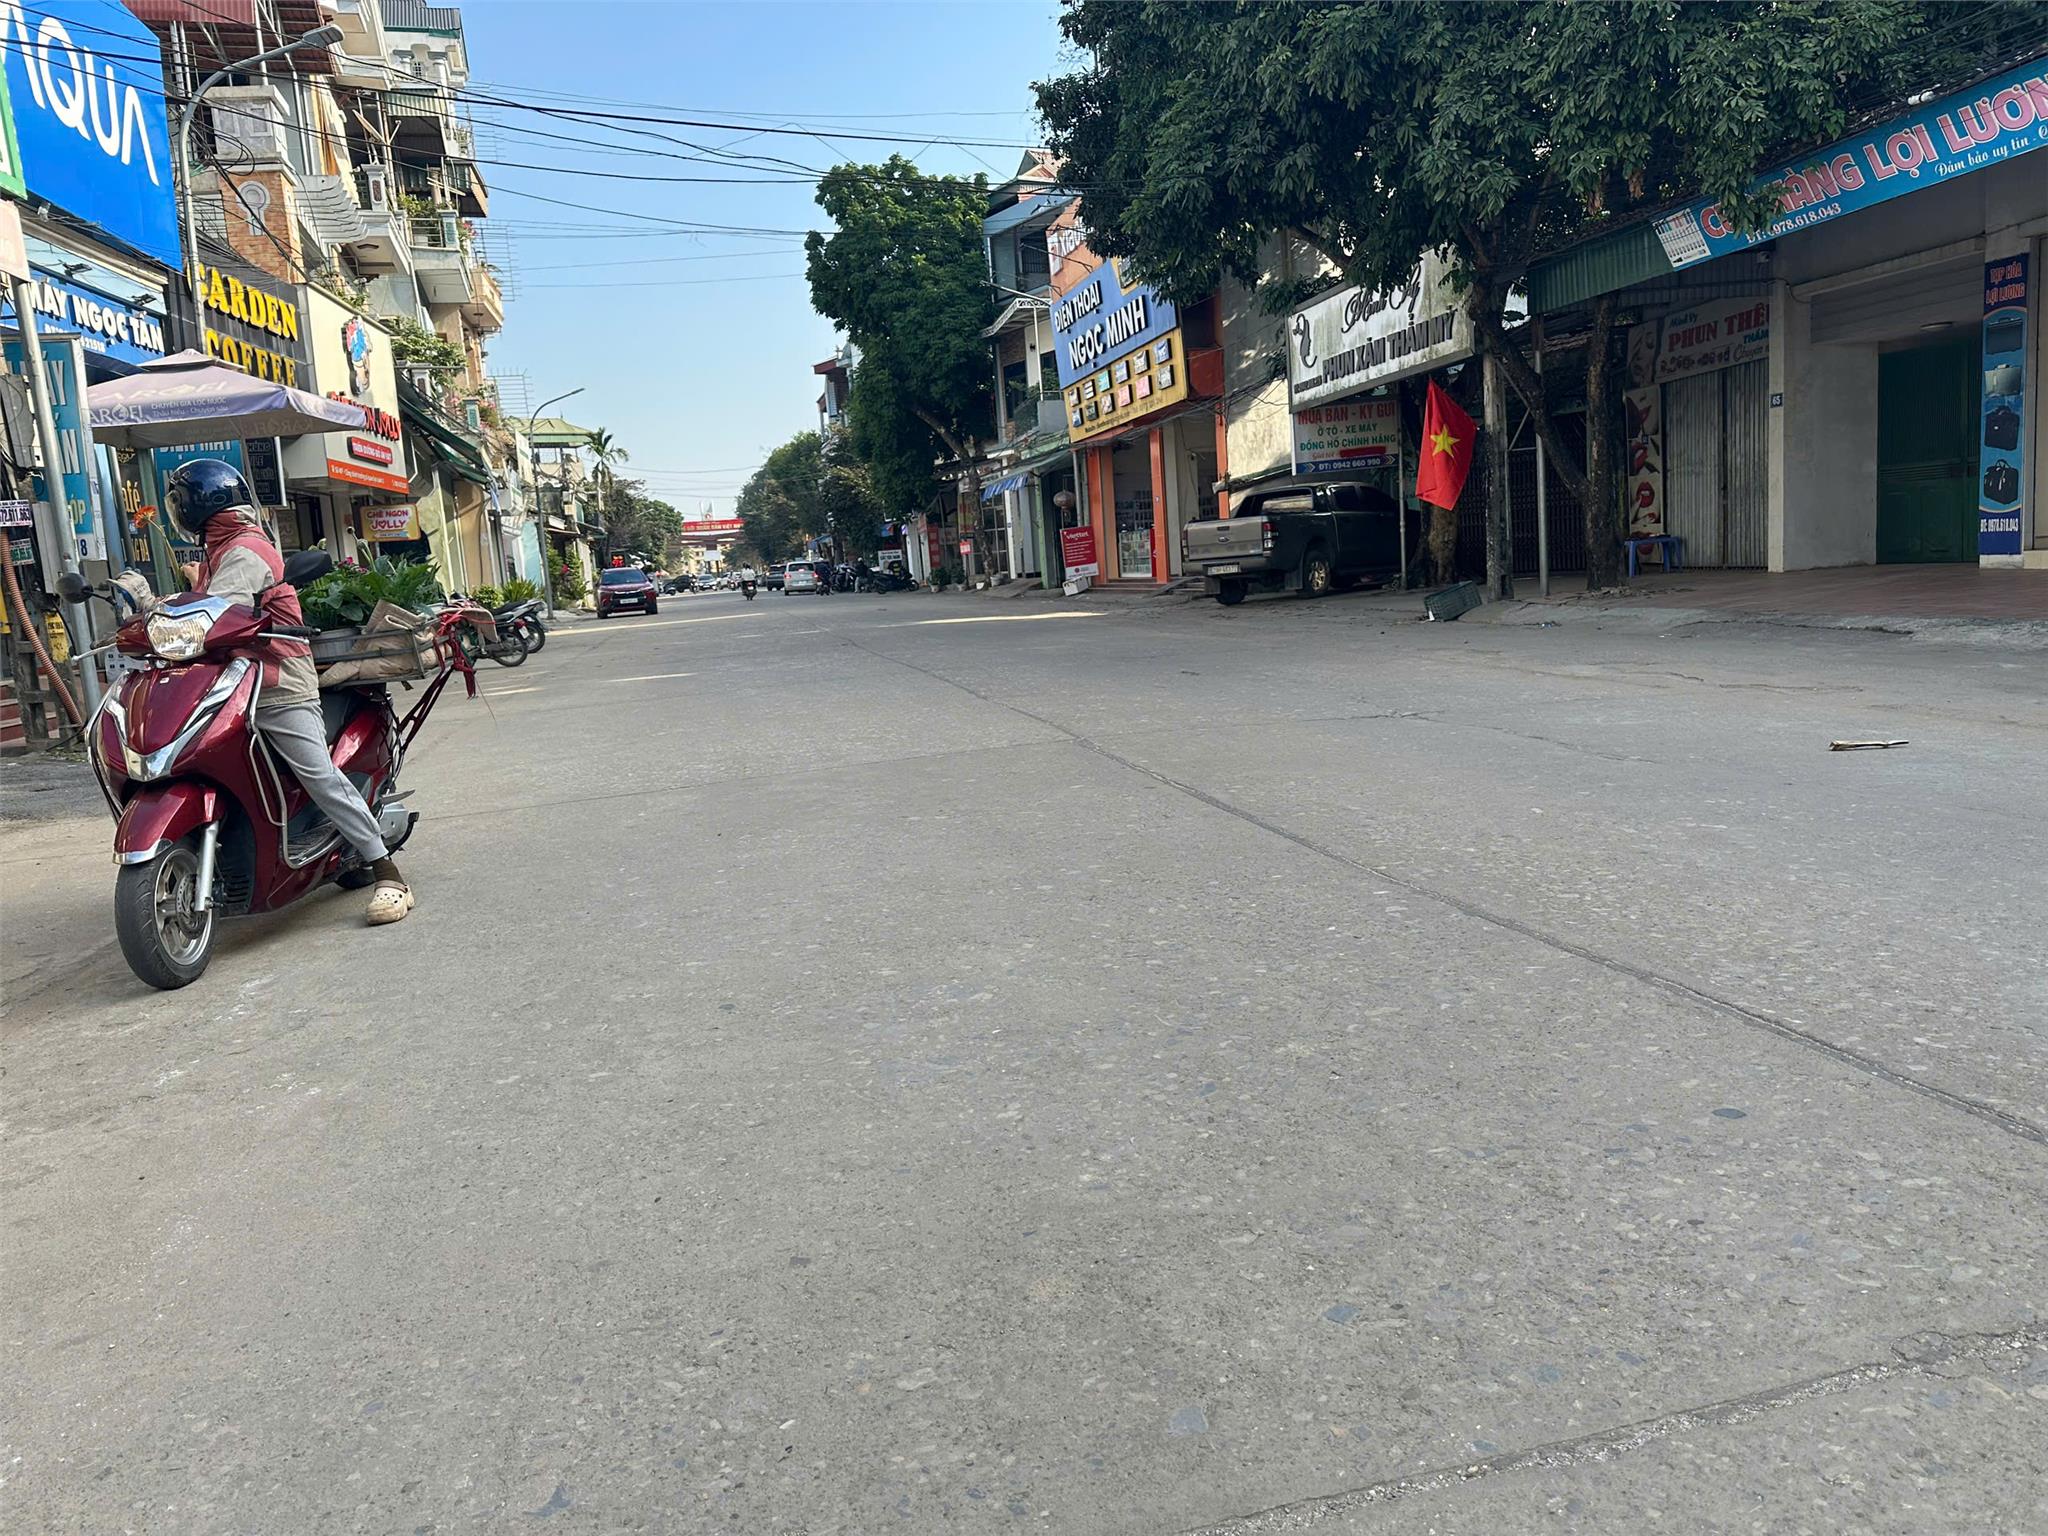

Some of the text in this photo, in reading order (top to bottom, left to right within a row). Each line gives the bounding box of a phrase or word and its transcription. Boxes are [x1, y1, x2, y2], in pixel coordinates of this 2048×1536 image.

[0, 0, 159, 187] AQUA
[1993, 145, 2009, 158] uy
[186, 262, 298, 342] GARDEN
[1072, 280, 1101, 325] THOẠI
[72, 294, 129, 345] NGỌC
[1068, 296, 1146, 369] NGỌC MINH
[1668, 320, 1718, 353] PHUN
[1322, 348, 1354, 383] PHUN
[90, 402, 143, 424] AROFI
[1297, 408, 1322, 424] MUA
[1772, 395, 1781, 405] 65
[1345, 425, 1356, 434] XE
[121, 480, 142, 513] afé
[0, 508, 31, 522] 72.611.663
[386, 509, 409, 518] NGON
